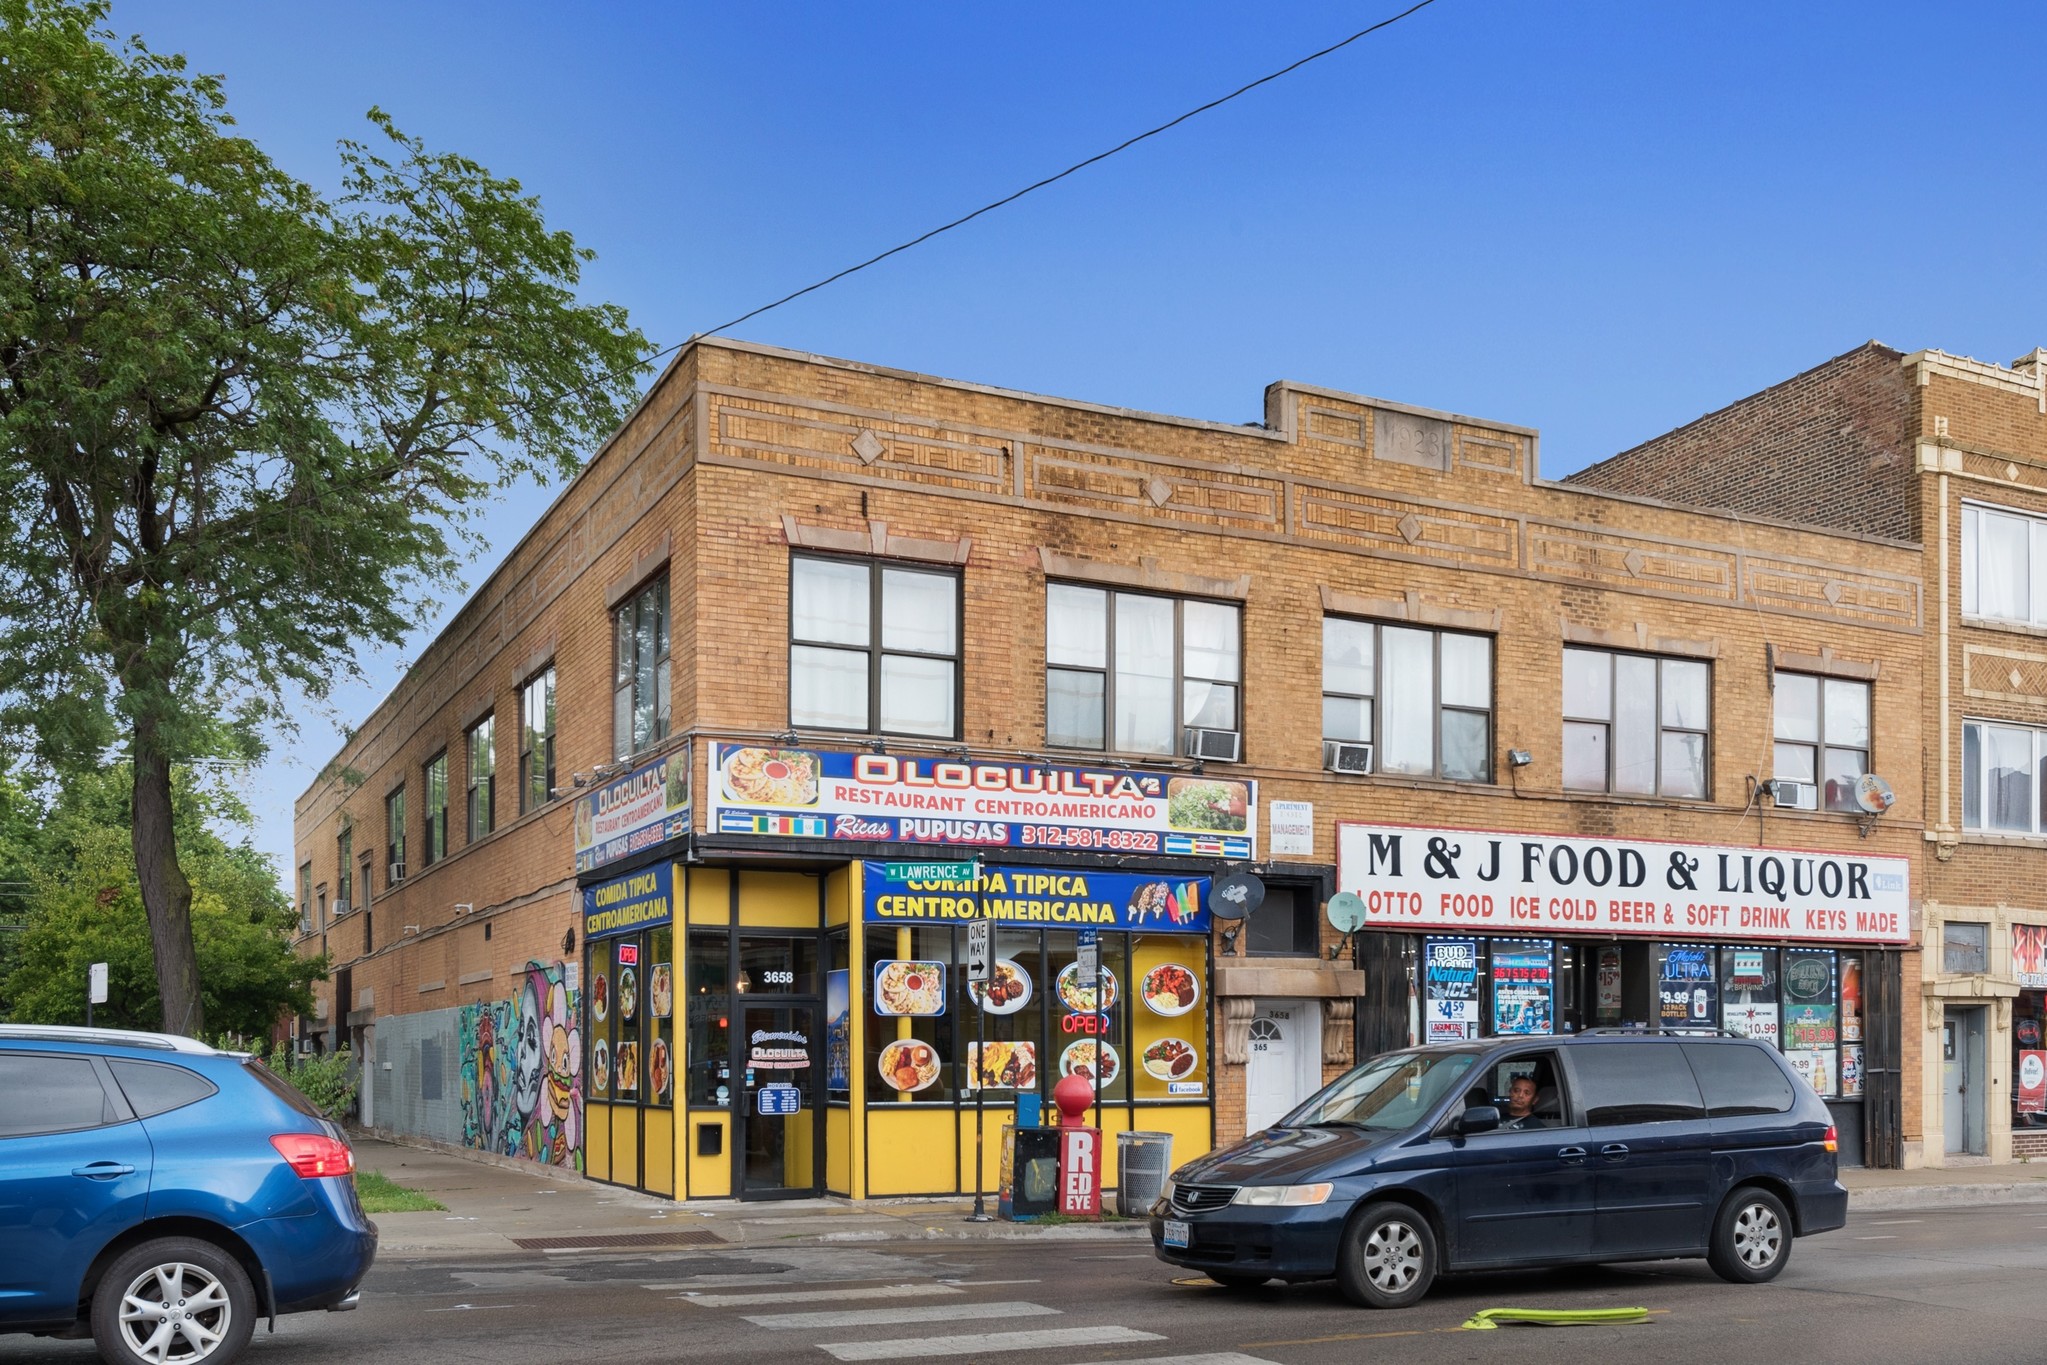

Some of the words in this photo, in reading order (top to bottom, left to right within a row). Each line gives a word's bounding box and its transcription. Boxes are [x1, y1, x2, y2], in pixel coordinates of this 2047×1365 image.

[854, 754, 1145, 801] OLOCUILTA
[599, 767, 661, 817] OLOCUILTA
[835, 785, 966, 812] RESTAURANT
[974, 799, 1156, 819] CENTROAMERICANO
[834, 814, 891, 840] Ricas
[900, 817, 1009, 845] PUPUSAS
[1022, 826, 1159, 851] 312-581-8322
[1272, 824, 1310, 836] MANAGEMENT
[890, 868, 896, 876] W
[900, 865, 959, 879] LAWRENCE
[962, 868, 970, 876] AV
[1367, 833, 1403, 877] M
[1423, 836, 1462, 880] &
[1477, 840, 1502, 882] J
[1520, 842, 1647, 888] FOOD
[1666, 850, 1699, 891] &
[1717, 853, 1872, 903] LIQUOR
[596, 880, 628, 908] COMIDA
[628, 872, 657, 899] TIPICA
[1011, 873, 1088, 897] TIPICA
[586, 896, 668, 934] CENTROAMERICANA
[876, 895, 1116, 923] CENTROAMERICANA
[1357, 889, 1422, 916] OTTO
[1440, 893, 1494, 918] FOOD
[1510, 896, 1540, 919] ICE
[1549, 898, 1597, 922] COLD
[1609, 900, 1656, 924] BEER
[1663, 902, 1675, 925] &
[1686, 903, 1730, 927] SOFT
[1740, 906, 1791, 929] DRINK
[1806, 909, 1847, 932] KEYS
[1856, 912, 1898, 934] MADE
[970, 924, 986, 940] ONE
[620, 947, 637, 963] OPEN
[969, 941, 987, 957] WAY
[1435, 946, 1467, 960] BUD
[763, 971, 794, 984] 3658
[1428, 965, 1478, 983] Natural
[1665, 962, 1710, 978] ULTRA
[1445, 981, 1473, 998] ICE
[1659, 991, 1689, 1004] $9.99
[1270, 1010, 1290, 1020] 3658
[1062, 1014, 1107, 1034] OPEN
[1744, 1023, 1777, 1035] $10.99
[1795, 1027, 1836, 1042] $15.99
[751, 1047, 809, 1060] OLOCUILTA
[1254, 1043, 1268, 1052] 365
[1178, 1085, 1201, 1093] facebook
[1068, 1131, 1093, 1173] R
[1067, 1172, 1092, 1195] ED
[1066, 1195, 1091, 1210] EYE
